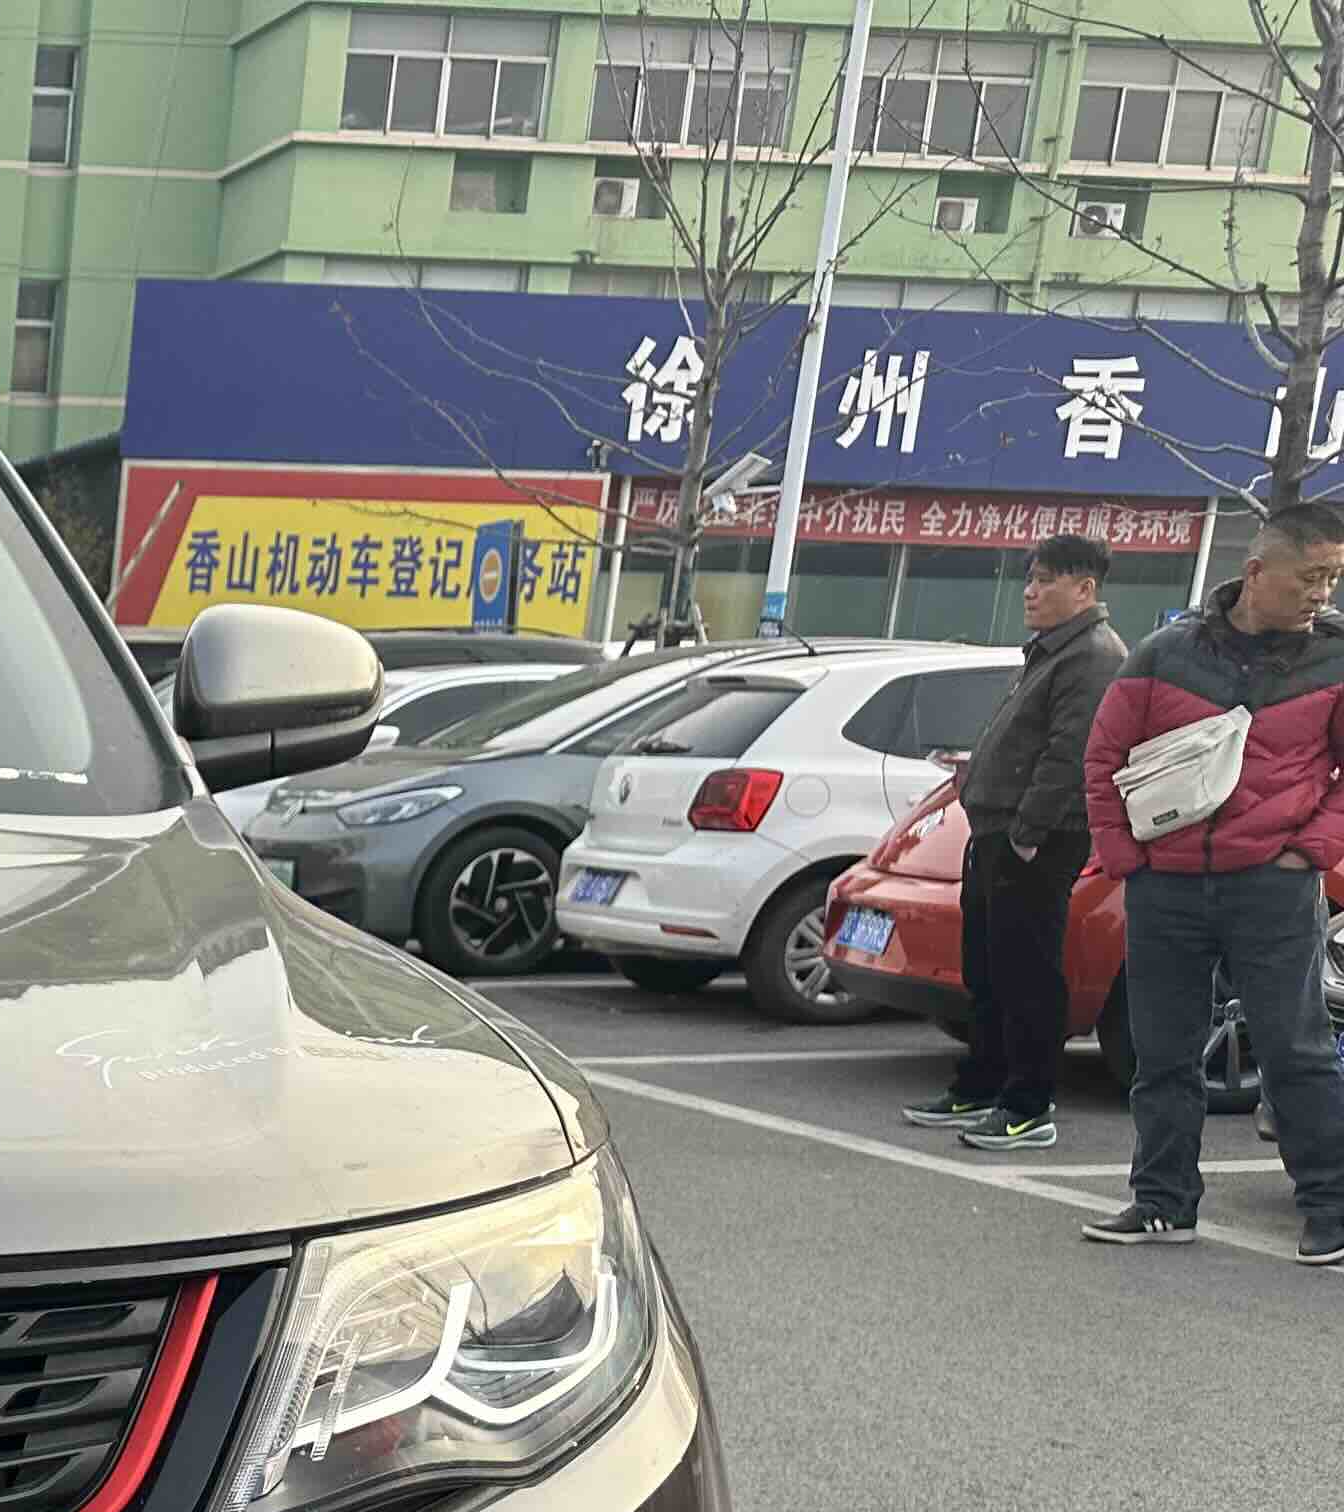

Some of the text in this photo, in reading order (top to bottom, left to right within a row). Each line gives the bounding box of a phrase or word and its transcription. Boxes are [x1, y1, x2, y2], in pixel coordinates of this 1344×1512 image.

[185, 529, 585, 604] 香山机动车登记务站
